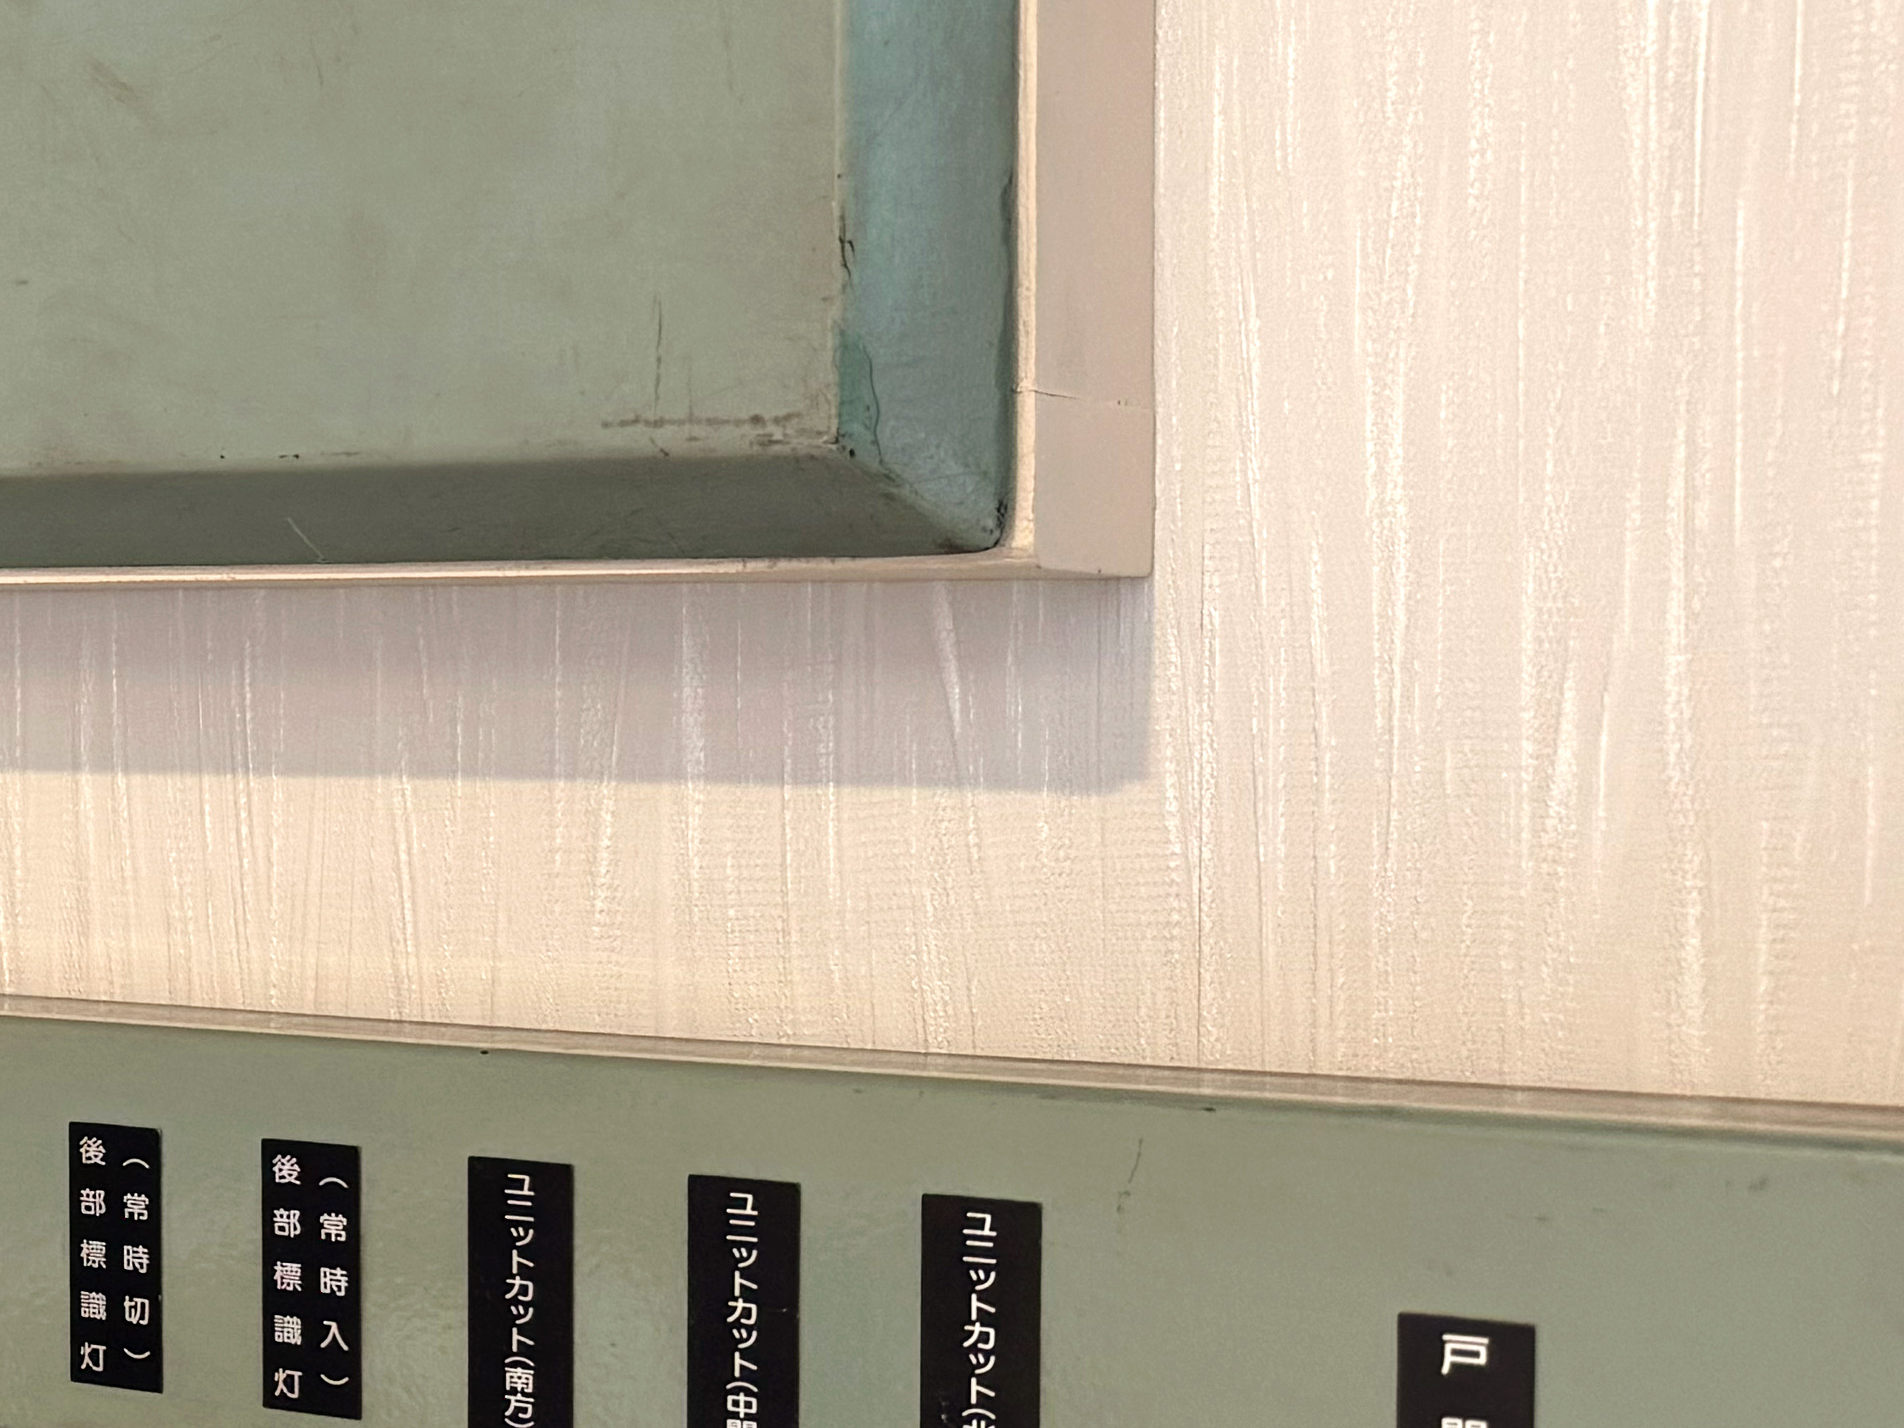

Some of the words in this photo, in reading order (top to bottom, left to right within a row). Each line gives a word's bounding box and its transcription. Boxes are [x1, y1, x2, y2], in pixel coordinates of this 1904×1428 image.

[78, 1136, 108, 1372] 後部標識灯
[271, 1154, 303, 1400] 後部標識灯
